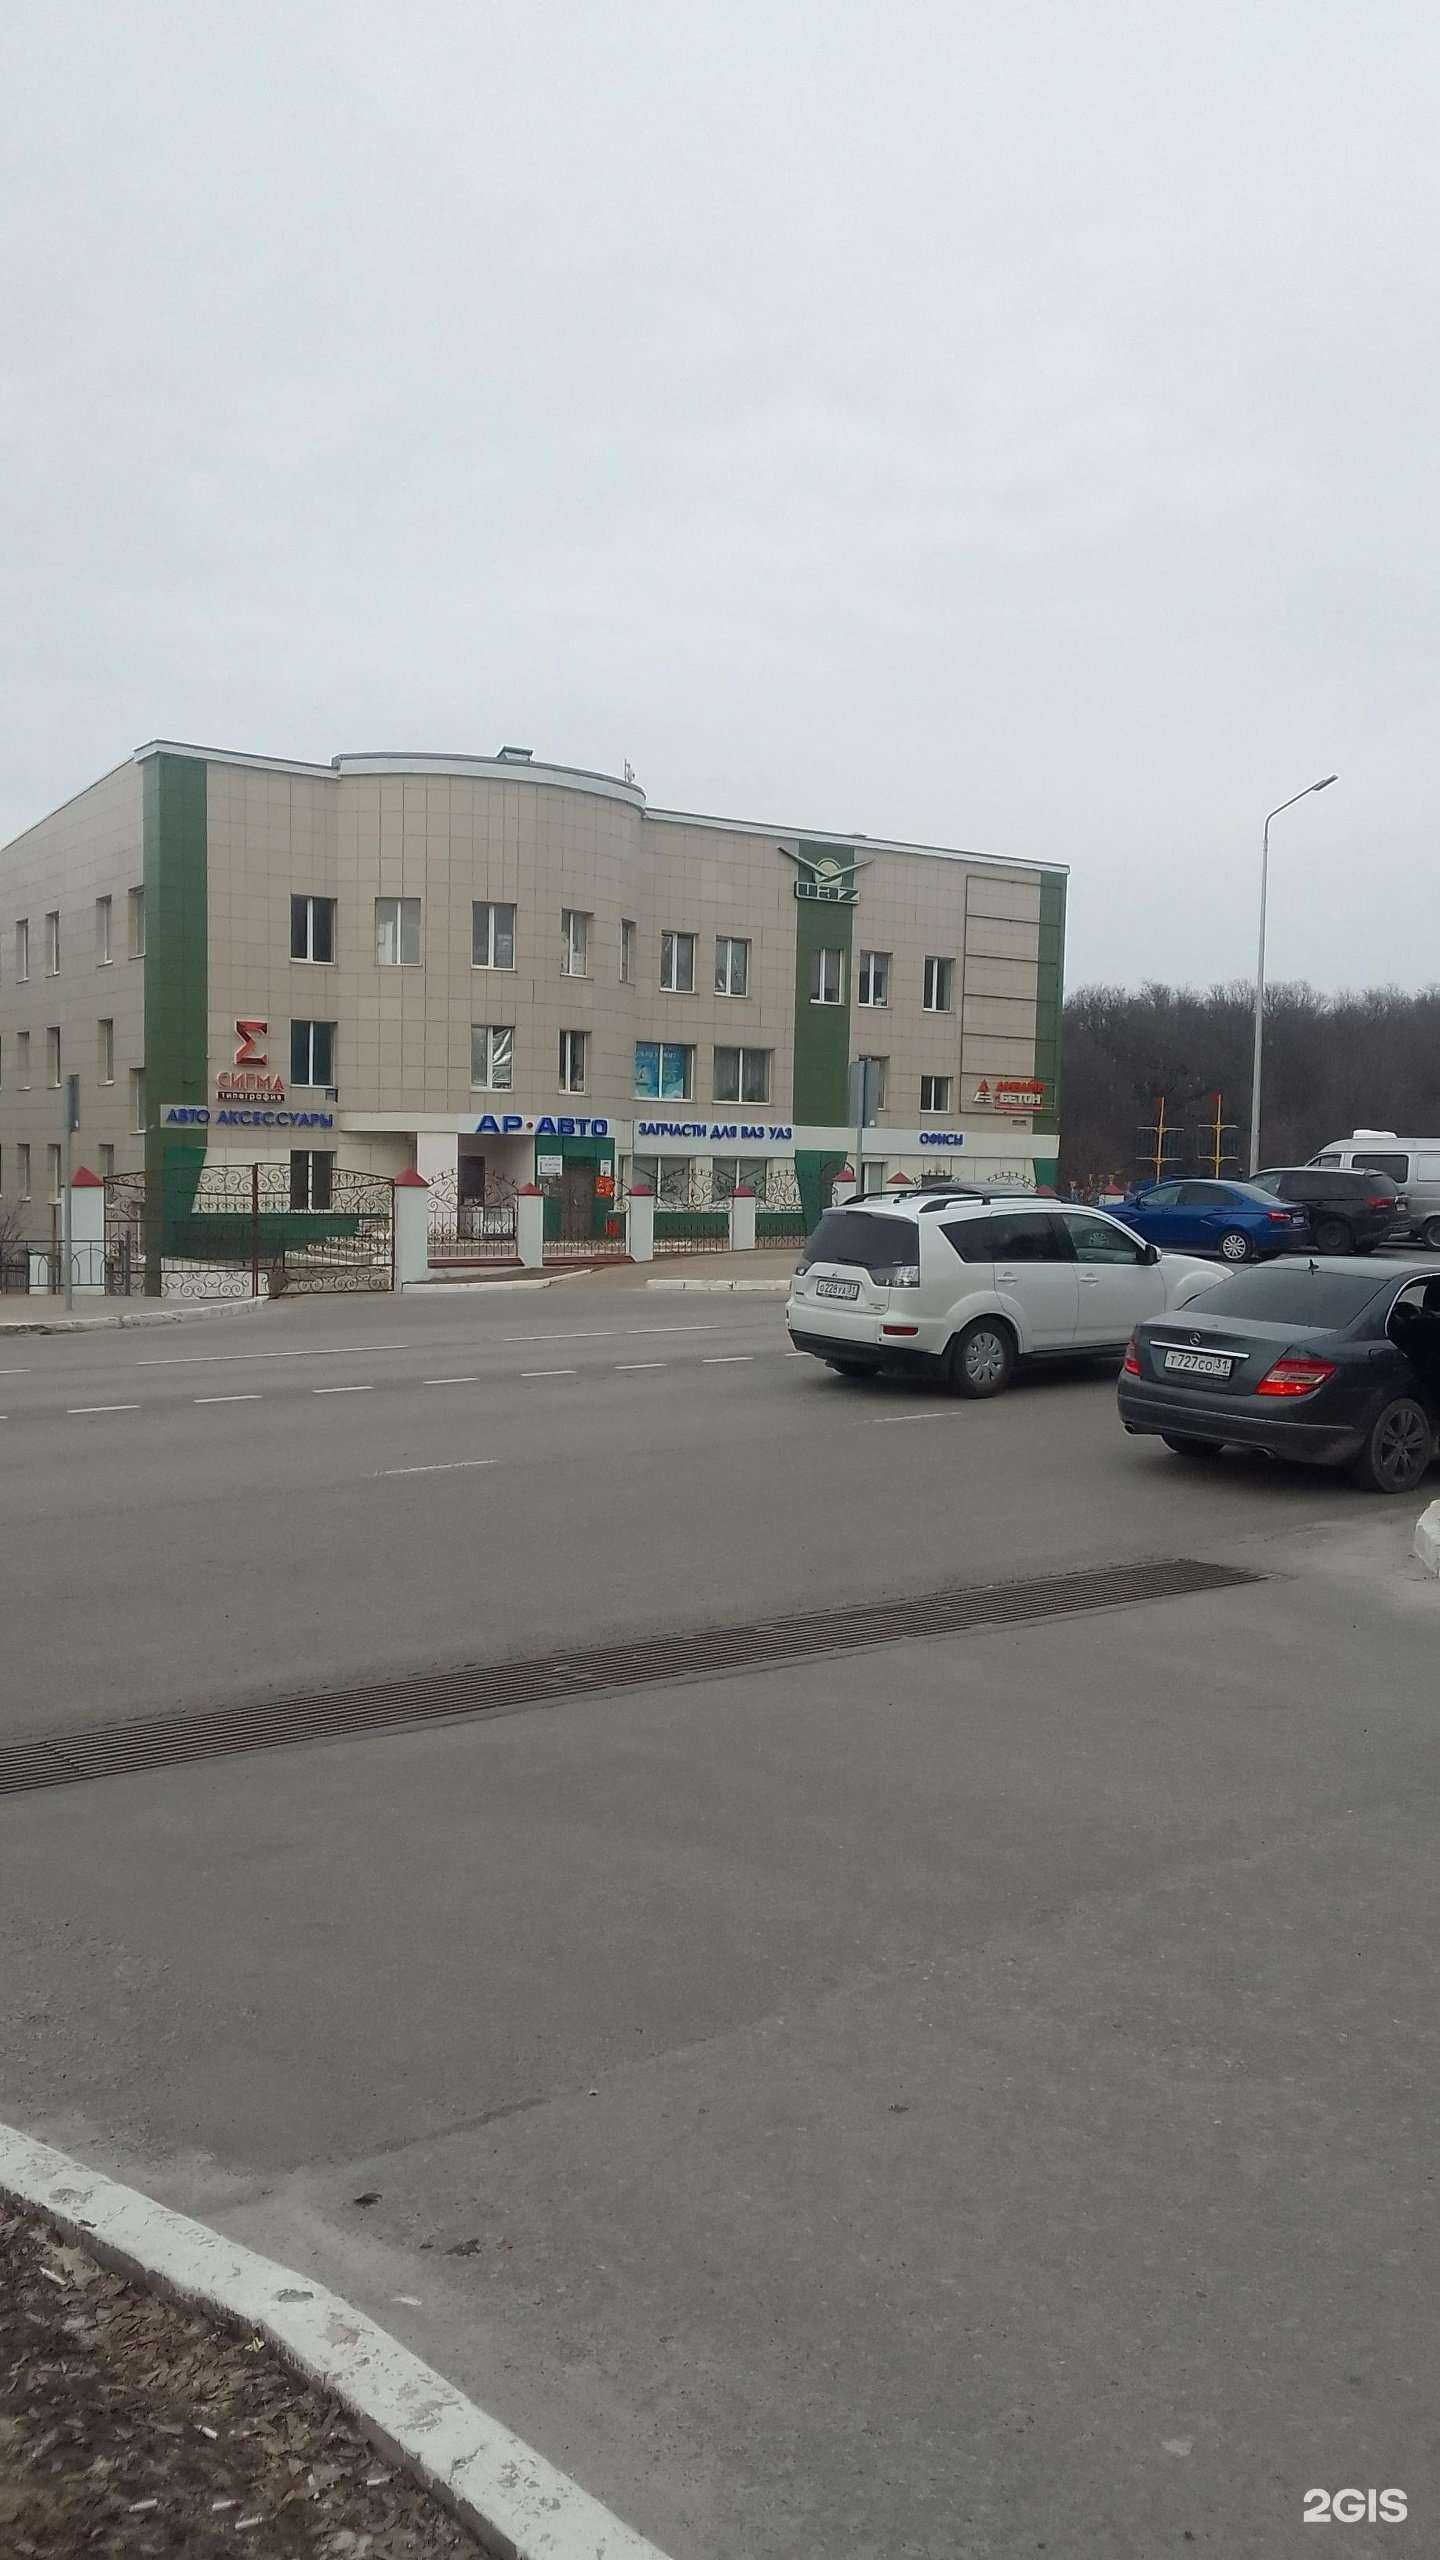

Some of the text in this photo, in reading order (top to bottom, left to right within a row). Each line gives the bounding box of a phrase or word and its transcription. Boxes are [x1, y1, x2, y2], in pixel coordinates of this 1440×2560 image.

[216, 1071, 285, 1093] СИГМА
[999, 1093, 1041, 1105] БЕТОН
[166, 1108, 334, 1129] АВТО АКСЕССУАРЫ
[638, 1122, 793, 1141] ЗАПЧАСТИ ДЛЯ ВАЗ УАЗ
[919, 1132, 964, 1146] ОФИСЫ
